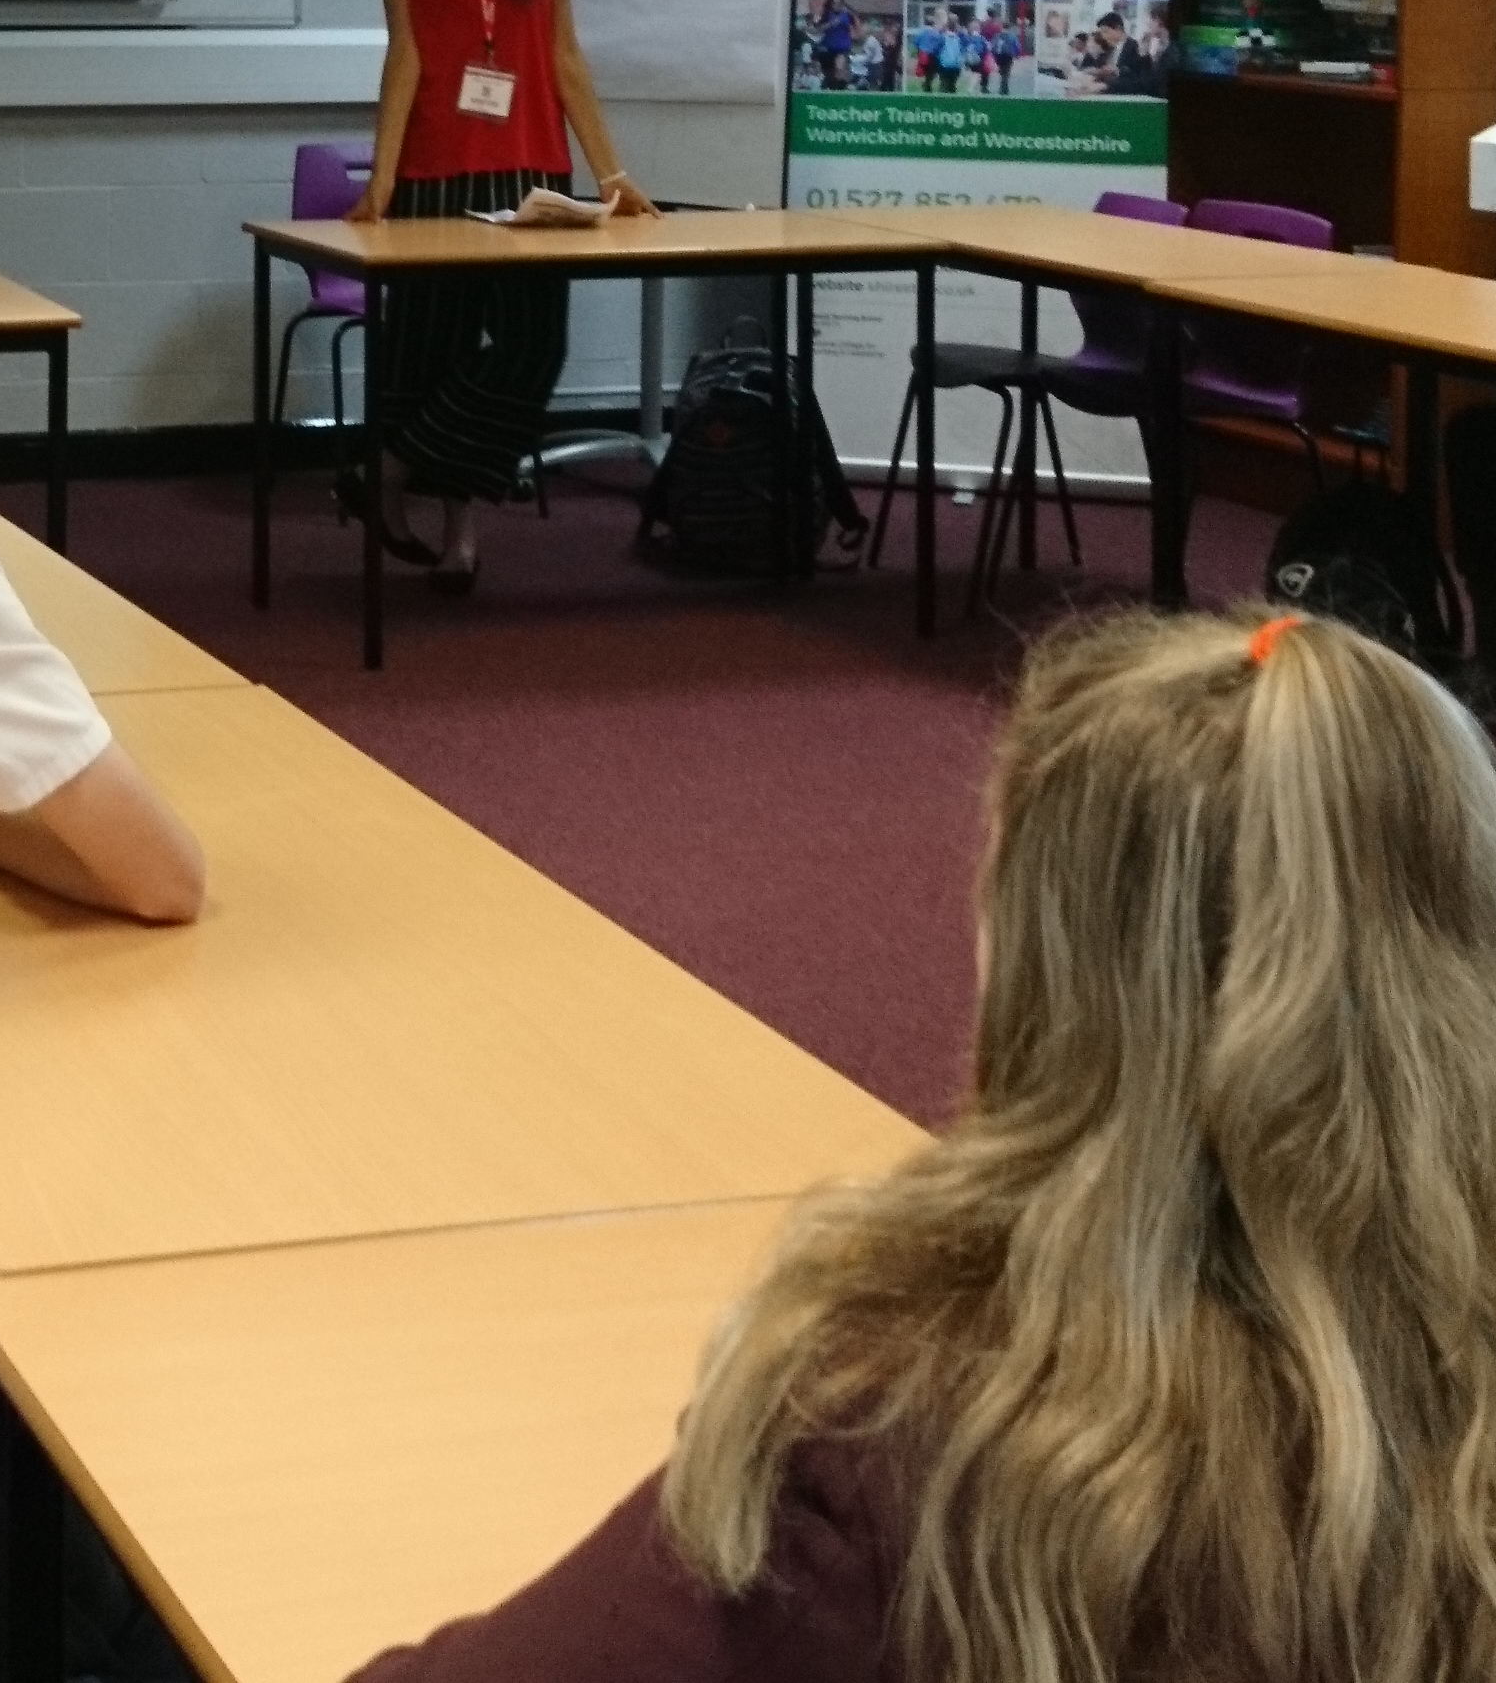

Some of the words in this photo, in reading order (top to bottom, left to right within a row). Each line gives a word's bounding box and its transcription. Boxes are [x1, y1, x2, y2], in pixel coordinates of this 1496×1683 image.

[806, 104, 880, 123] Teacher
[887, 106, 965, 128] Training
[969, 109, 989, 126] in
[805, 127, 935, 147] Warwickshire
[939, 131, 978, 148] and
[983, 132, 1131, 153] Worcestershire
